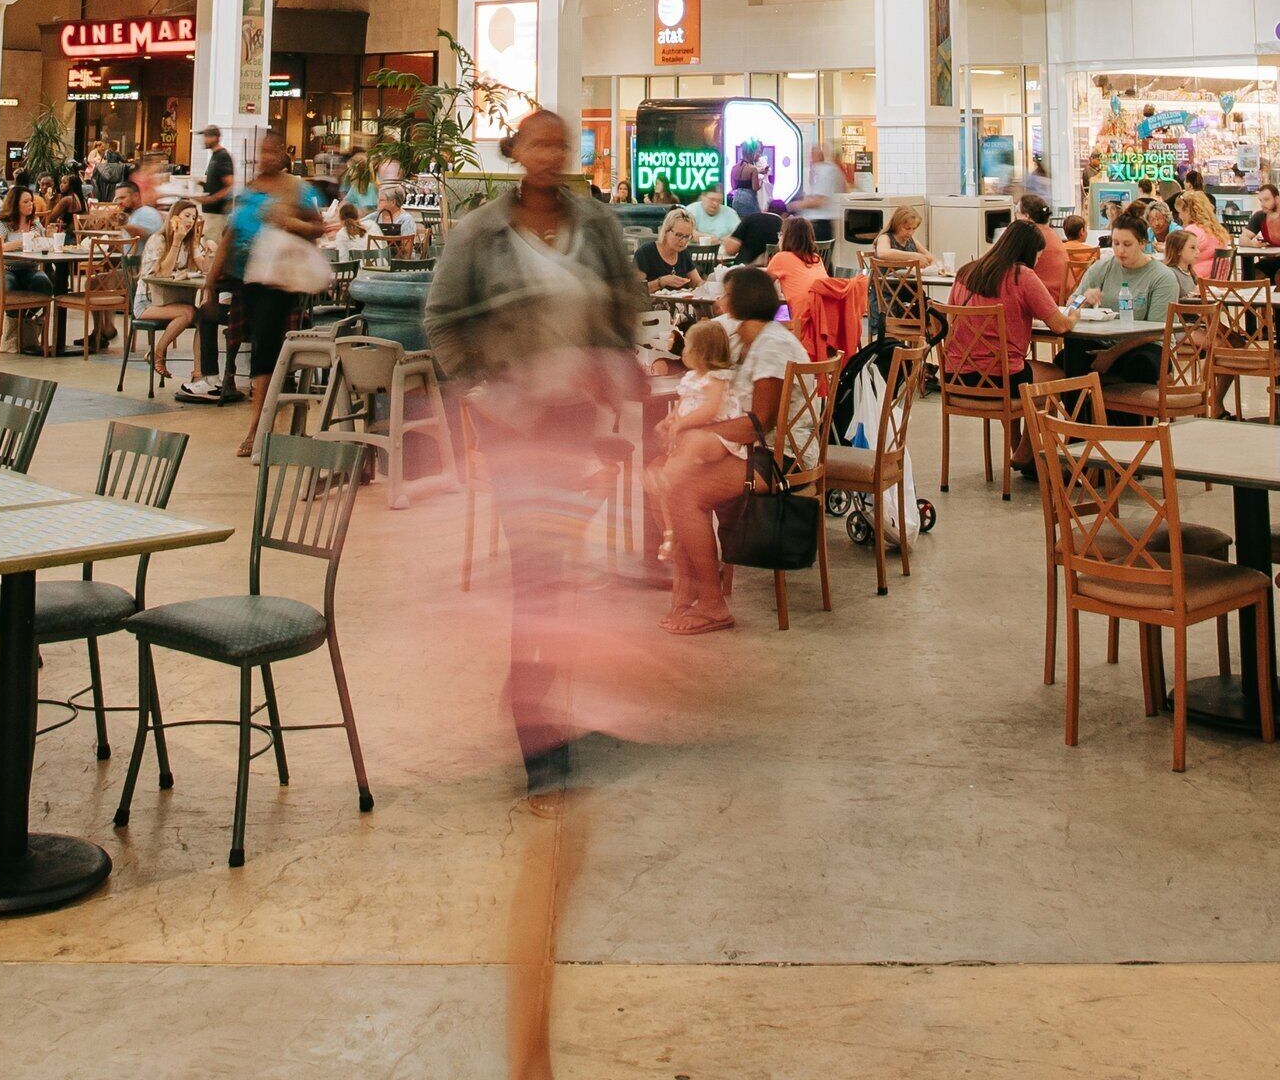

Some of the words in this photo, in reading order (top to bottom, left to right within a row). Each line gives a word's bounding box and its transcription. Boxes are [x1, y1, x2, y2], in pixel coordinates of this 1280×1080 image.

[61, 19, 194, 56] CINEMAR
[662, 47, 695, 56] Authorized
[662, 55, 684, 63] Retailer
[638, 151, 677, 167] PHOTO
[677, 151, 719, 167] STUDIO
